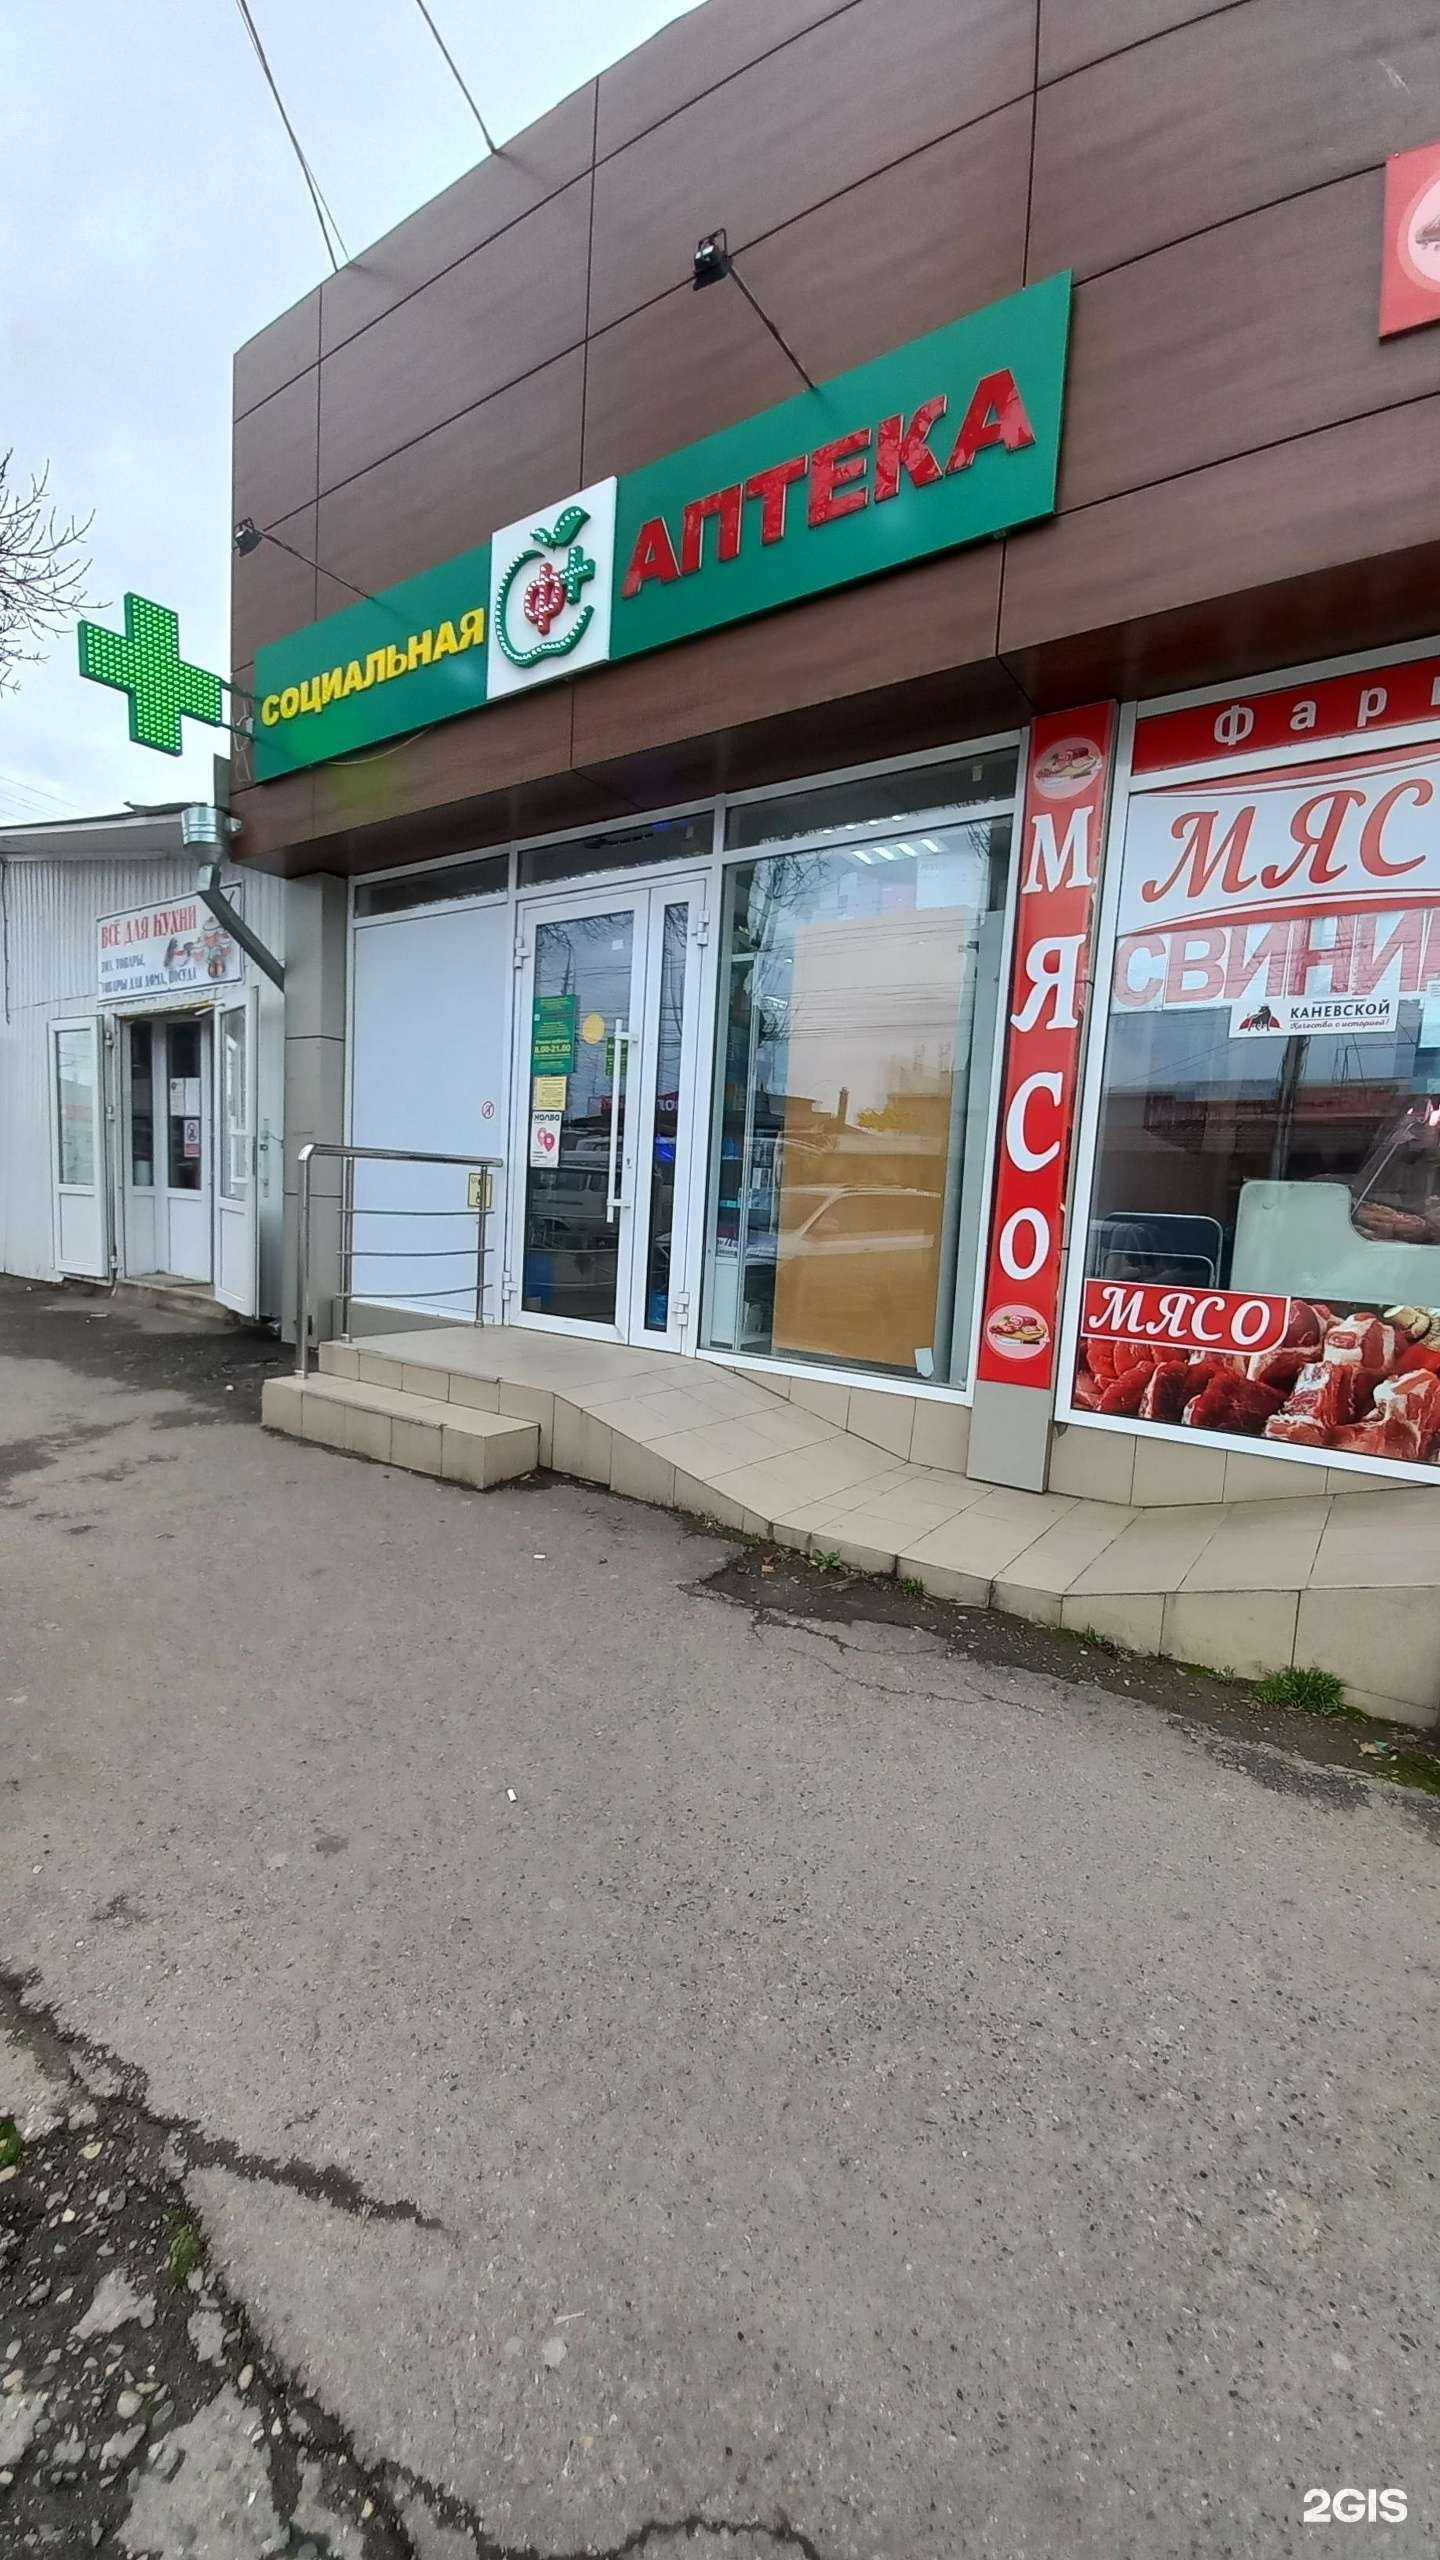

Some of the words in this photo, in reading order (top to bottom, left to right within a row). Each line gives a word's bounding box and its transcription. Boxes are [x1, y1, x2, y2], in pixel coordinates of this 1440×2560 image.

[621, 368, 1036, 600] АПТЕКА
[261, 607, 486, 727] СОЦИАЛЬНАЯ
[1213, 675, 1440, 745] Фар
[124, 916, 149, 944] ДЛЯ
[153, 905, 197, 937] КУХНИ
[1000, 805, 1095, 1281] МЯСО
[1290, 999, 1390, 1019] КАНЕВСКОЙ
[1088, 1286, 1271, 1346] МЯСО
